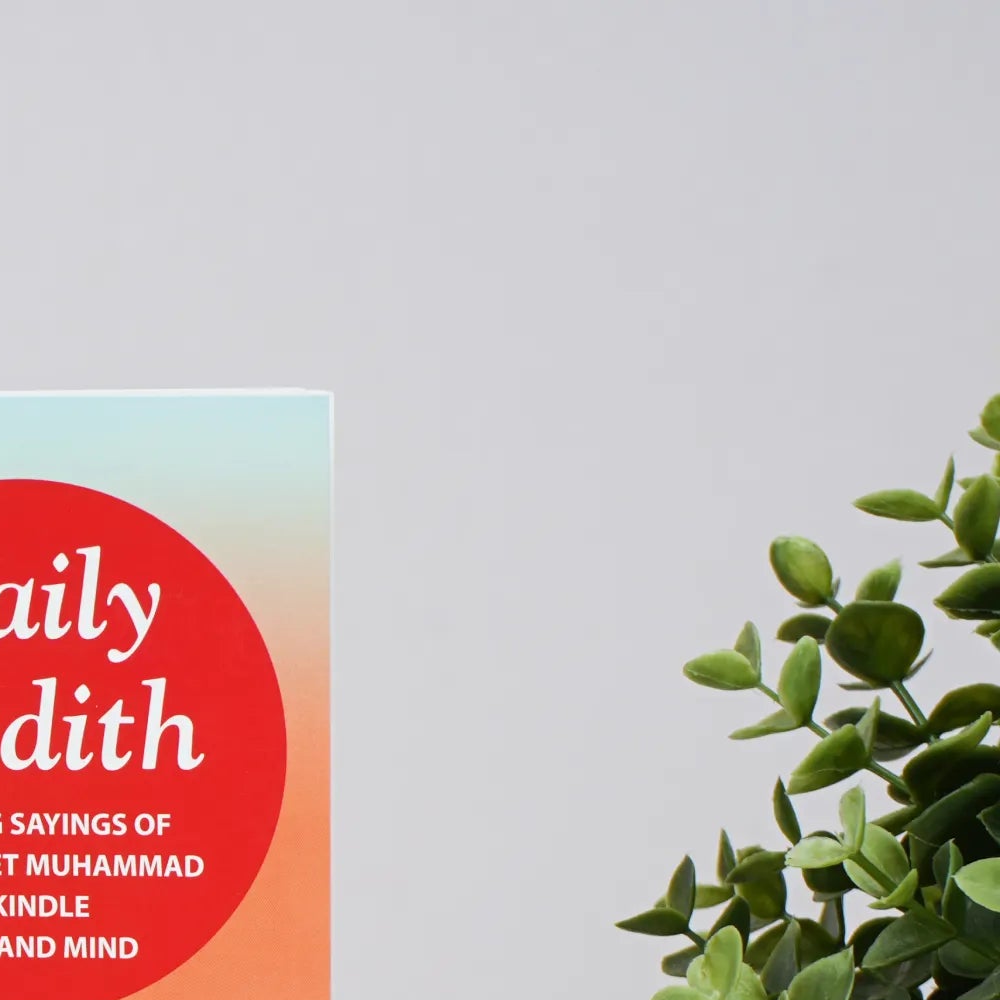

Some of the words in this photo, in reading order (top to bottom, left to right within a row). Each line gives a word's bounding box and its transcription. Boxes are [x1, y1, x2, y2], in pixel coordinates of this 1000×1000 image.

[10, 812, 128, 836] SAYINGS
[134, 813, 171, 836] OF
[25, 853, 205, 878] MUHAMMAD
[63, 936, 139, 960] MIND
